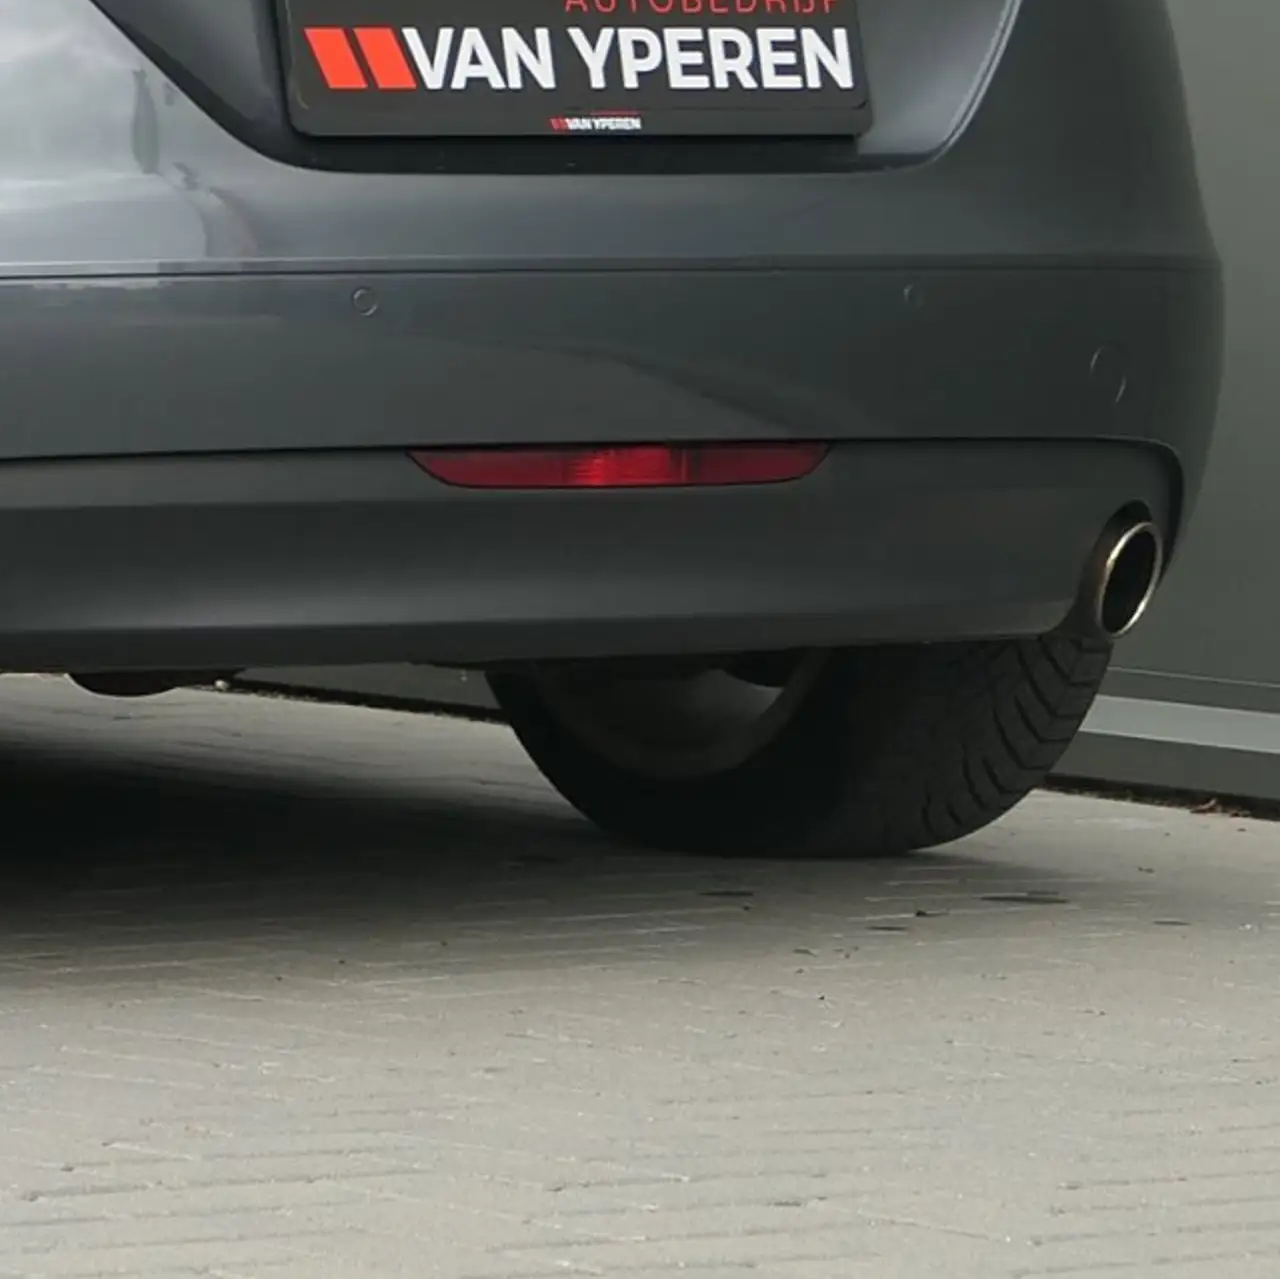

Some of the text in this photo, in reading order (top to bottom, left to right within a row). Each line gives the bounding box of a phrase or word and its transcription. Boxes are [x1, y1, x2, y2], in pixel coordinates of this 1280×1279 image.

[402, 27, 854, 90] VAN YPEREN
[564, 116, 642, 131] VAN YPEREN
